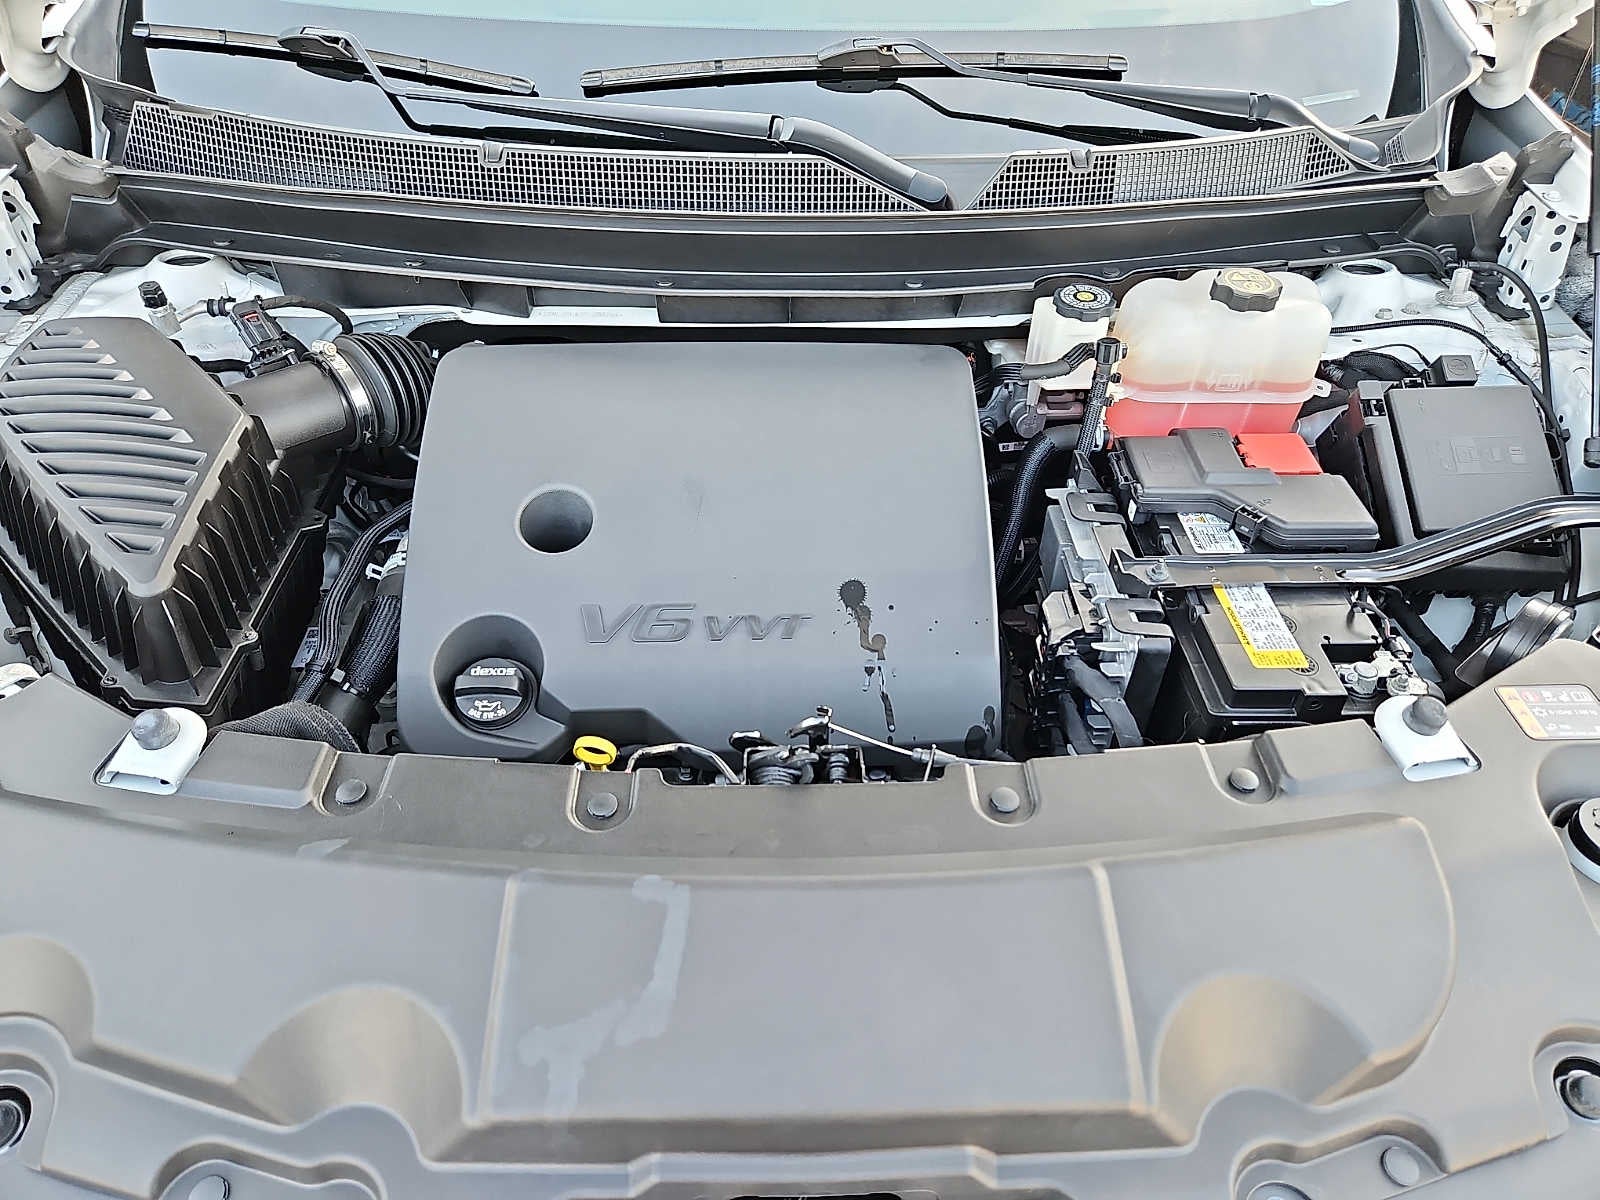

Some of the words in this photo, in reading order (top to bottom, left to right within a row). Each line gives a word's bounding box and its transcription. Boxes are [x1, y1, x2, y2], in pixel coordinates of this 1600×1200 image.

[580, 602, 697, 643] V6
[703, 614, 813, 641] VVT
[470, 666, 517, 676] dexos
